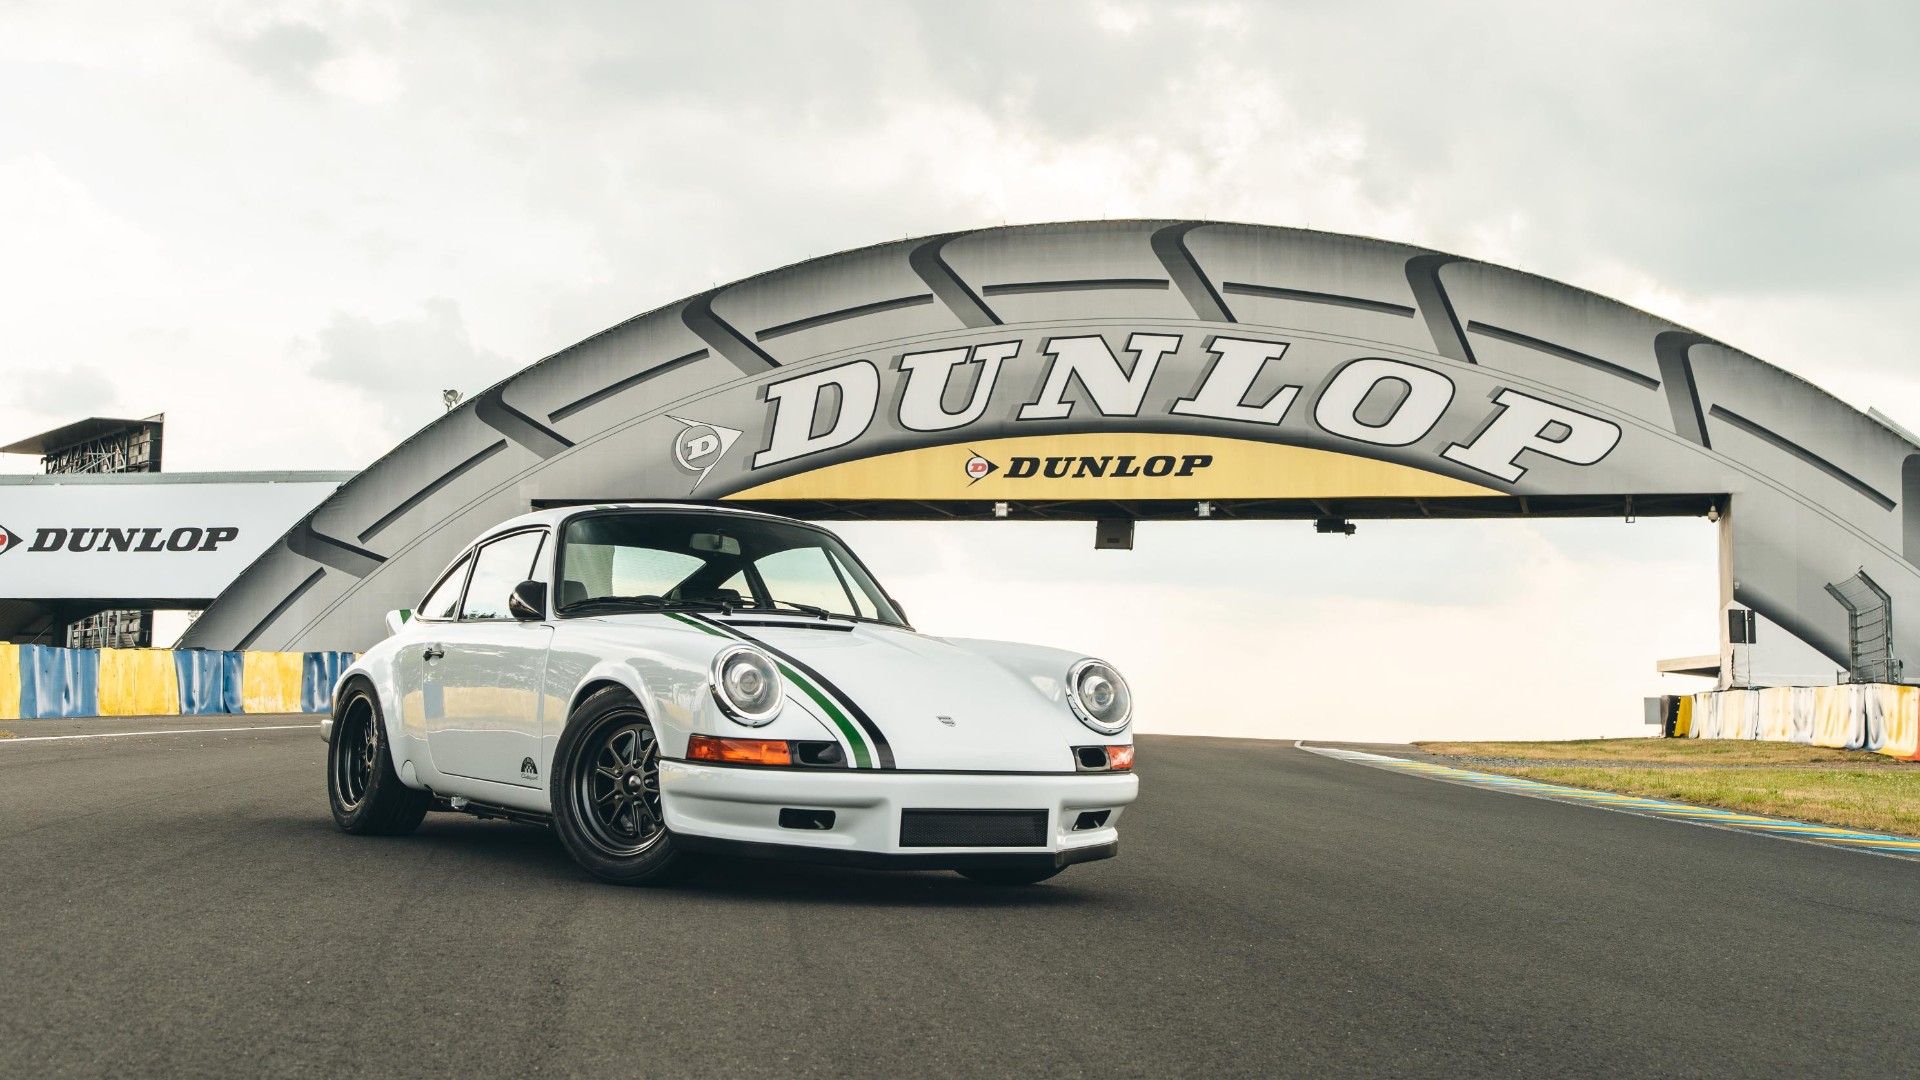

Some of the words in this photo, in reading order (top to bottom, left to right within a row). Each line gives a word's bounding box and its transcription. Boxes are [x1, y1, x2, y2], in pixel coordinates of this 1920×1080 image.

[687, 434, 719, 461] D
[751, 332, 1623, 484] DUNLOP
[970, 462, 987, 472] D
[1003, 455, 1213, 478] DUNLOP
[27, 527, 239, 552] DUNLOP
